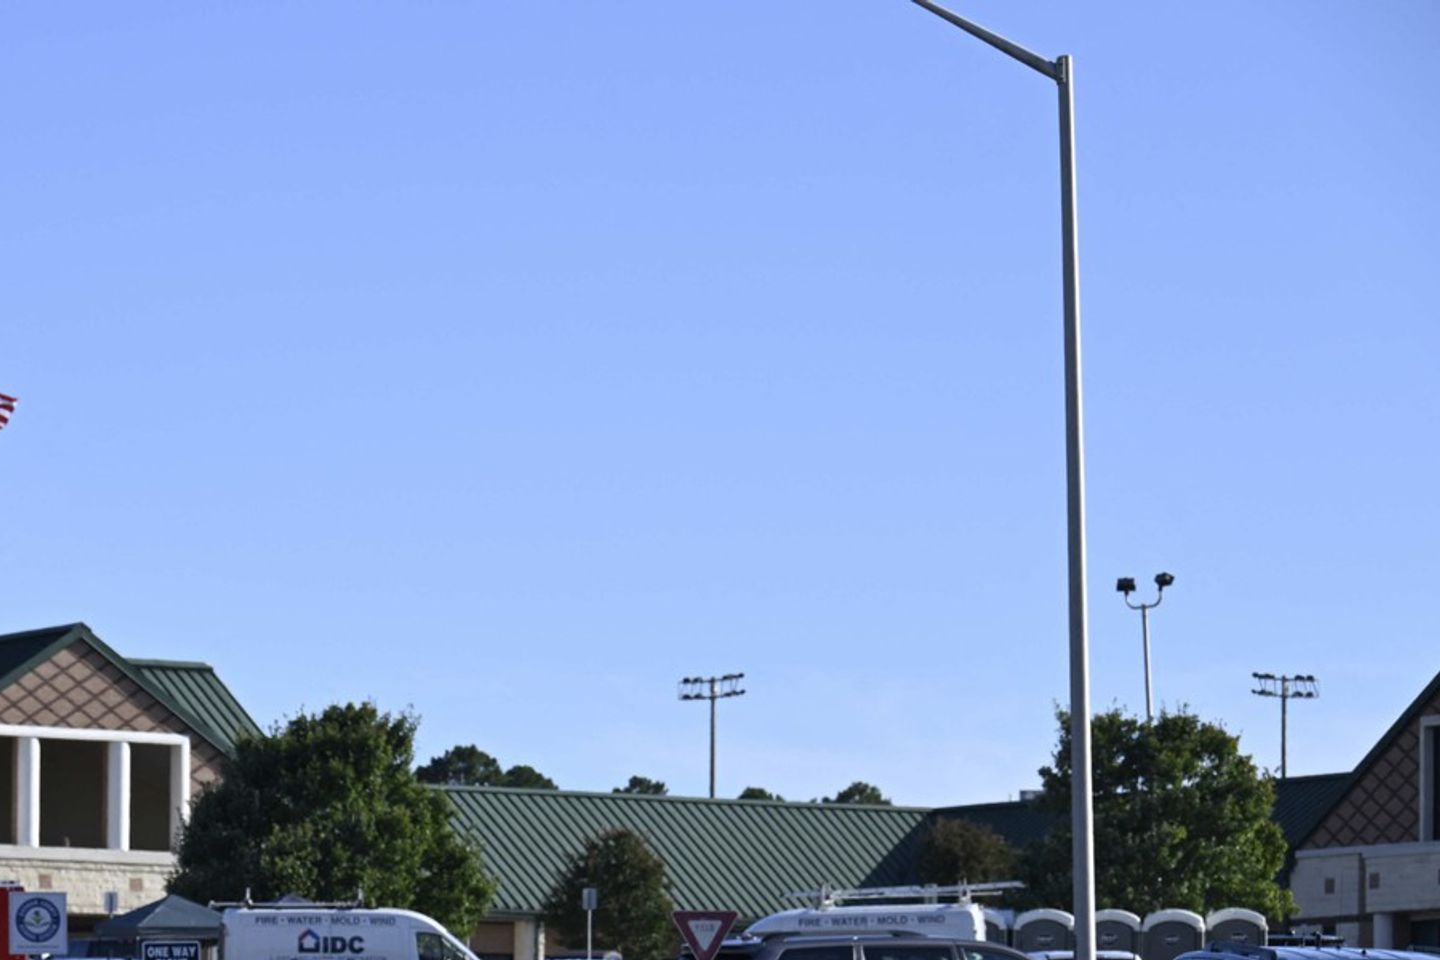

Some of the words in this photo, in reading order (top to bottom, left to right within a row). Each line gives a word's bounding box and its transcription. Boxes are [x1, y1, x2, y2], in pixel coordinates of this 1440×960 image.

[255, 916, 278, 924] FIRE
[287, 916, 321, 924] WATER
[330, 917, 360, 925] MOLD
[798, 918, 820, 927] FIRE
[831, 918, 868, 926] WATER
[877, 916, 908, 925] MOLD
[918, 915, 946, 924] WIND
[322, 936, 365, 954] IDC
[147, 946, 168, 958] ONE
[171, 946, 196, 958] WAY
